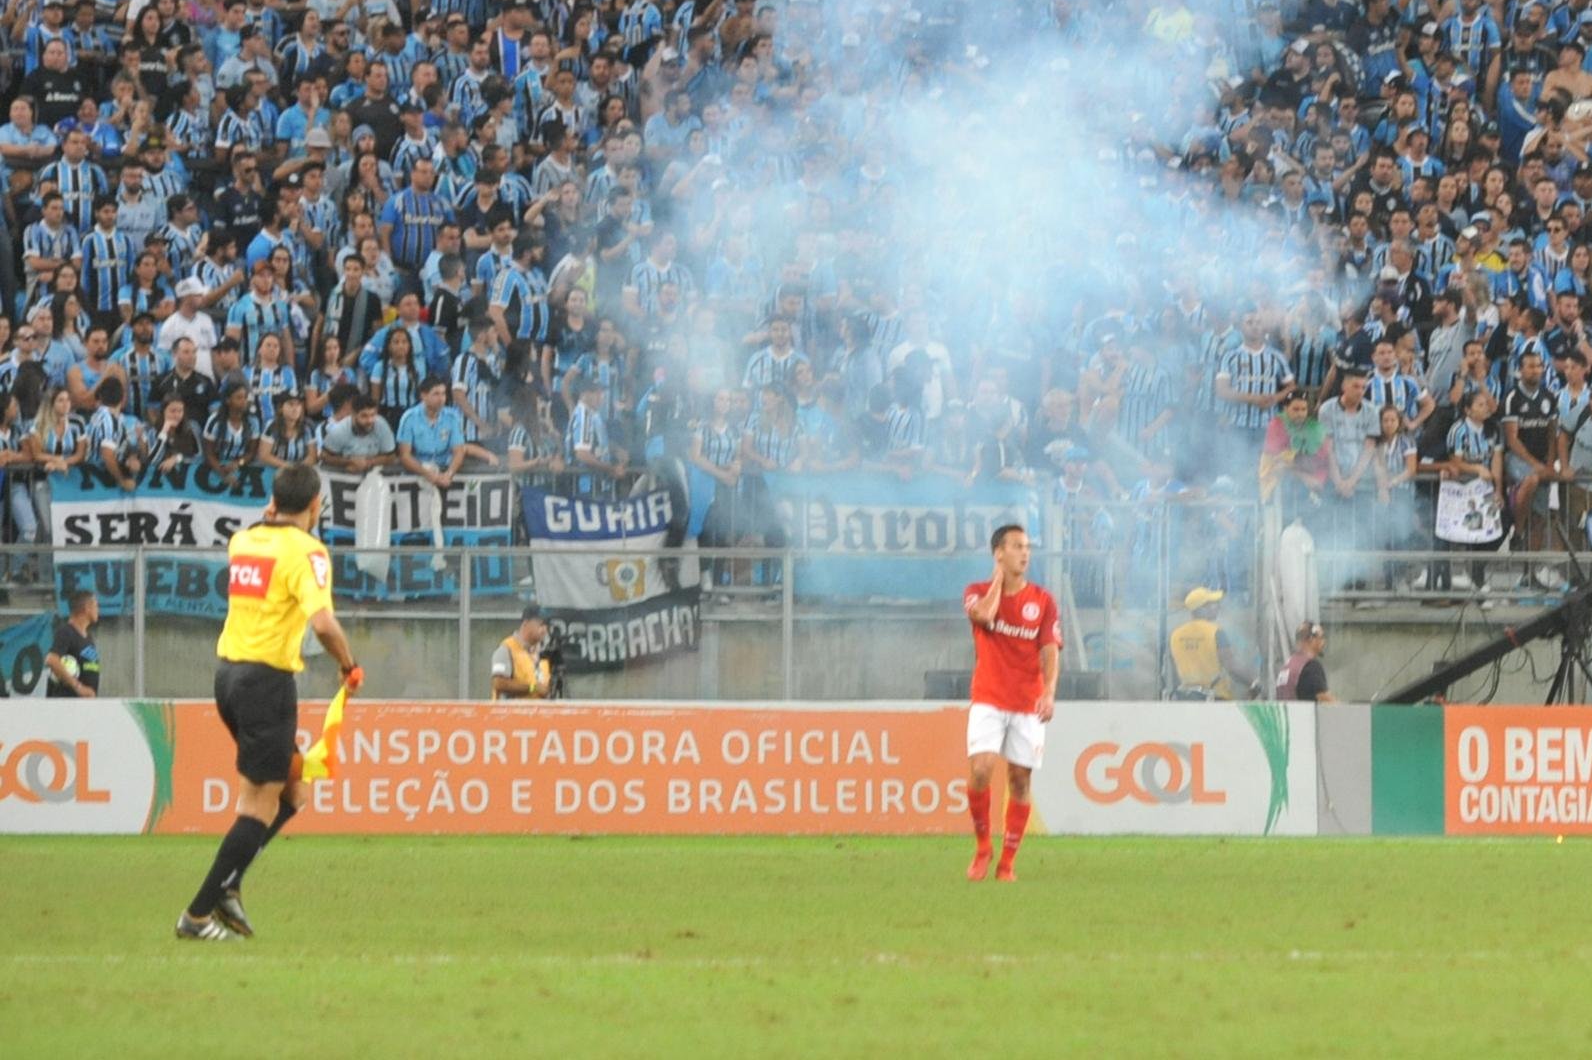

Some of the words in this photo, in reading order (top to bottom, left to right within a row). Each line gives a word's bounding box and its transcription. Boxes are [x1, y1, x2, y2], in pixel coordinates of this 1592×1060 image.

[63, 503, 198, 546] SERÁ
[721, 729, 899, 765] OFICIAL
[1073, 741, 1227, 805] GOL
[1458, 727, 1489, 782] O
[303, 769, 490, 821] ELEÇÃO
[511, 779, 533, 814] E
[555, 779, 647, 814] DOS
[667, 778, 969, 815] BRASILEIROS
